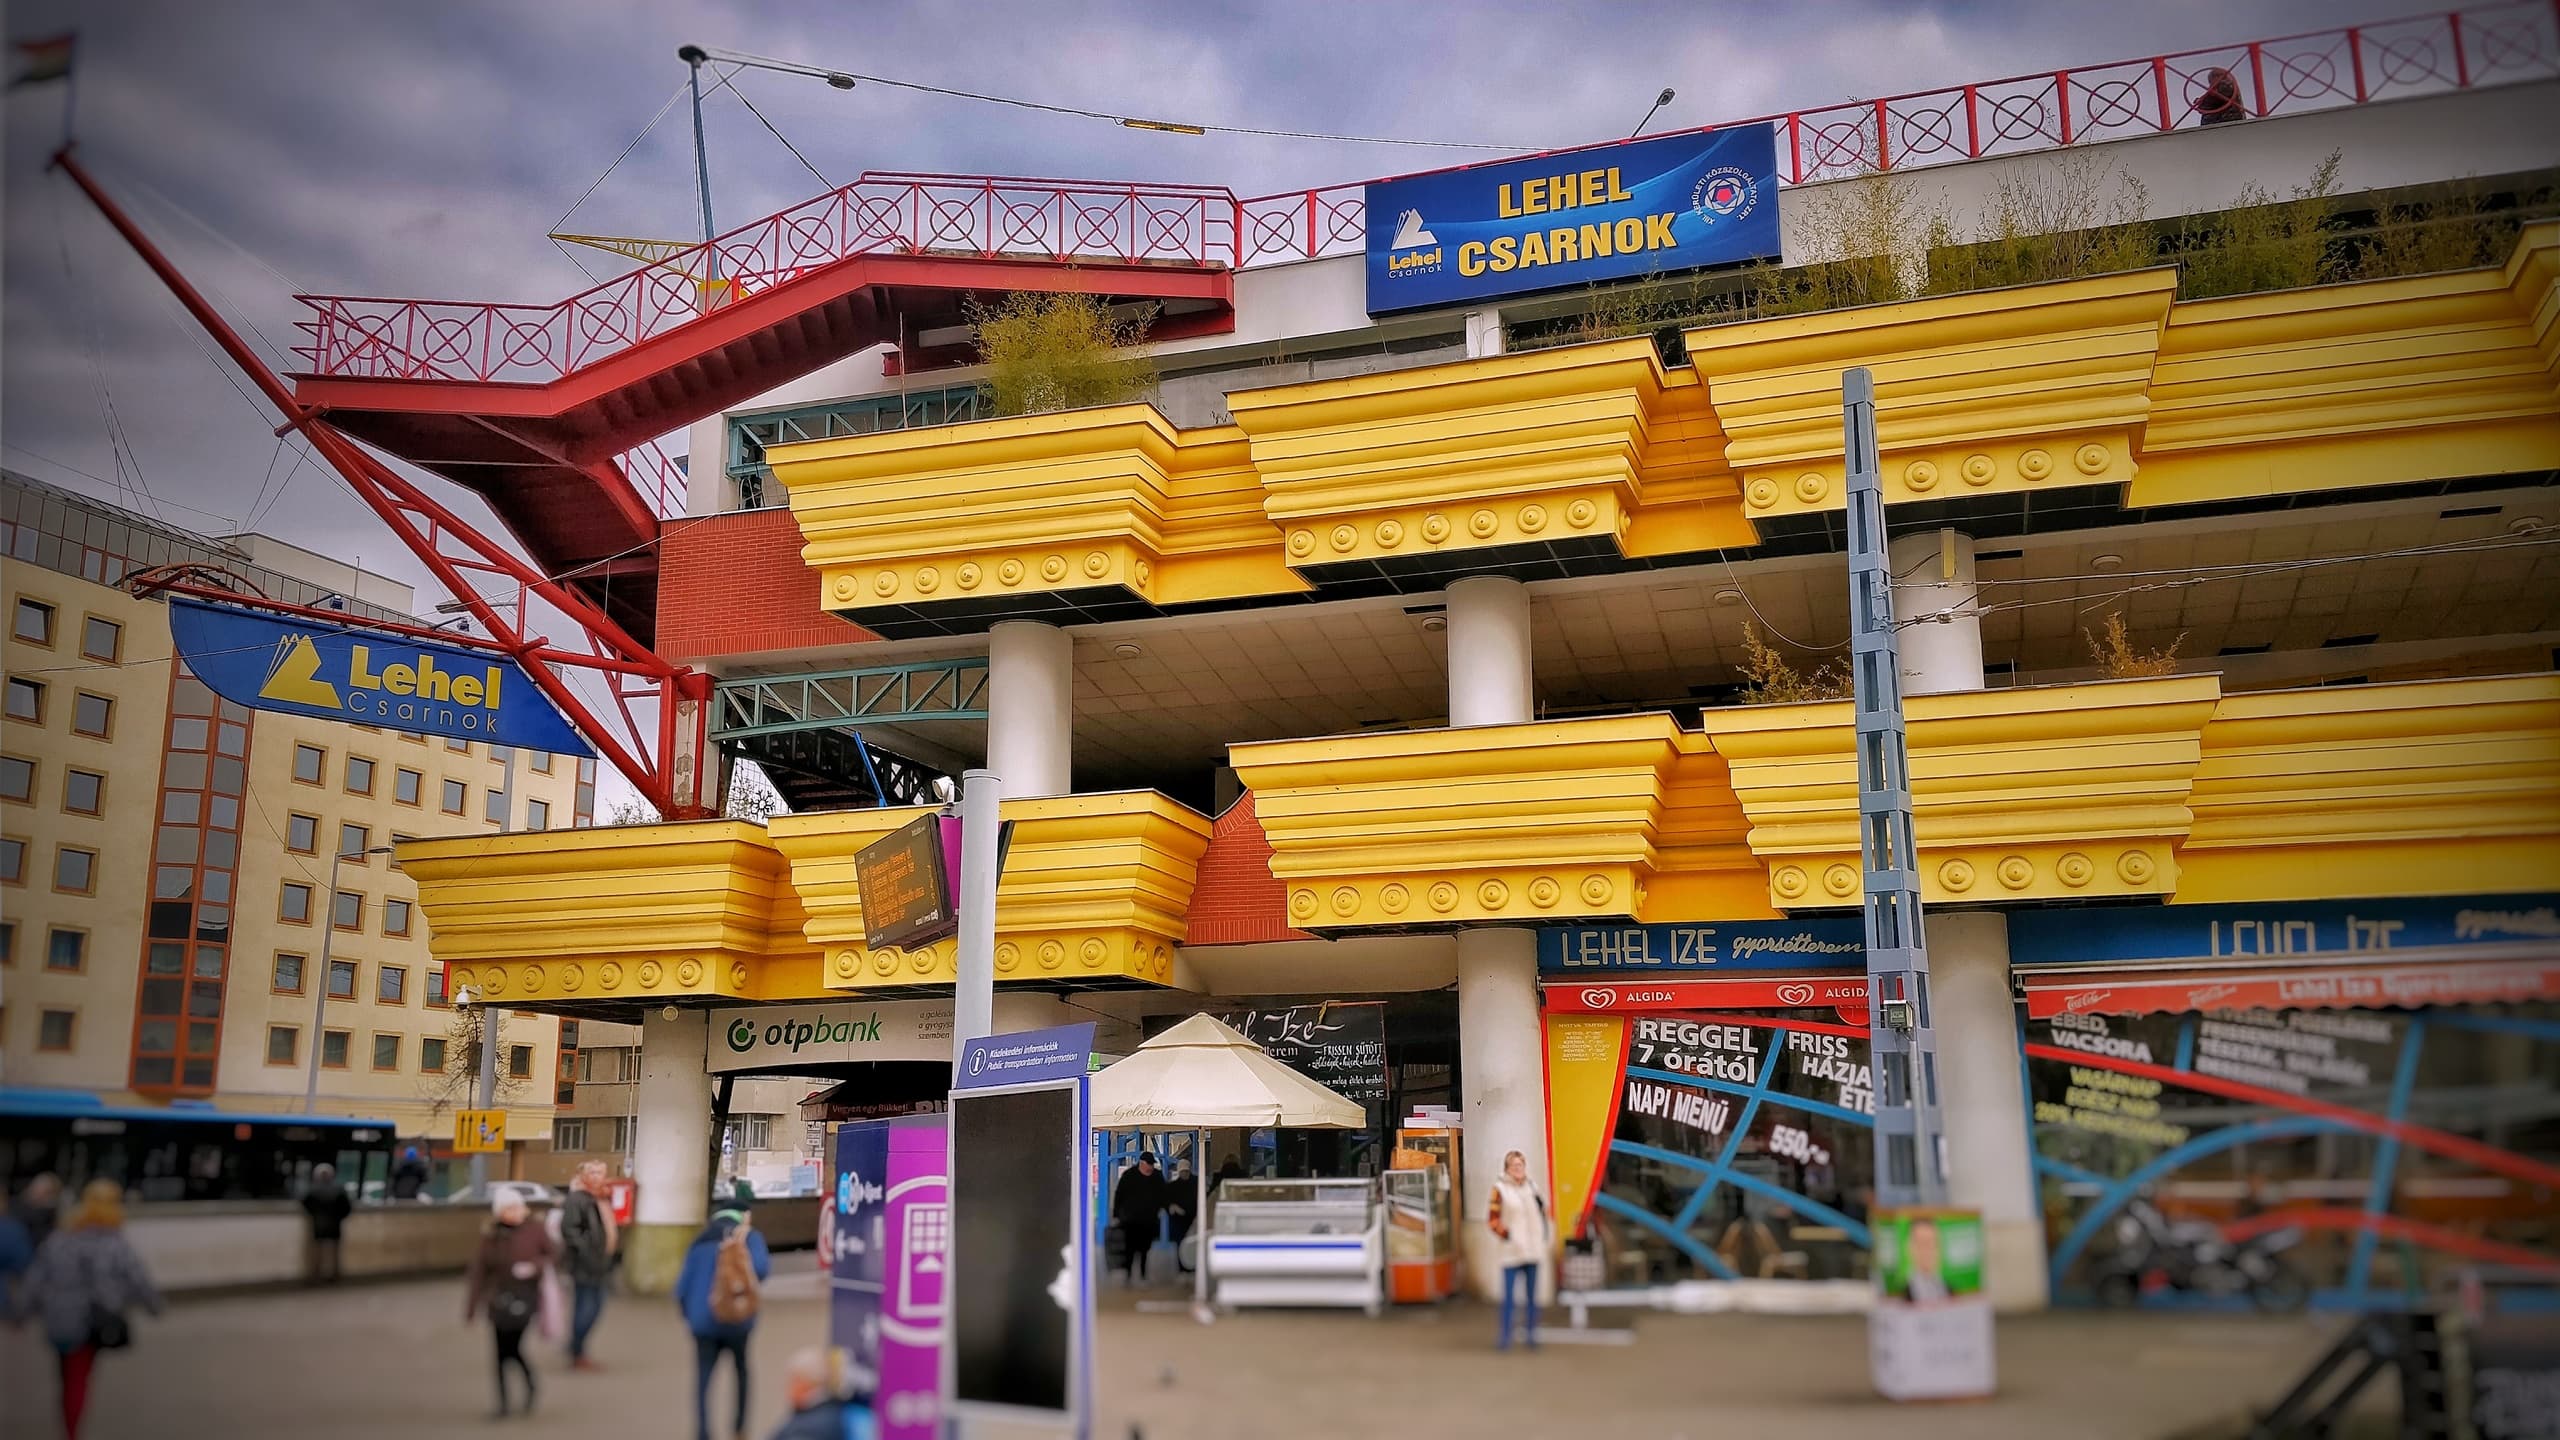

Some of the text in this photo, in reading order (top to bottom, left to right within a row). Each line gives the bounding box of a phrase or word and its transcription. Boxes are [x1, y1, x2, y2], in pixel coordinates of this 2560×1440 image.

[1499, 167, 1631, 218] LEHEL
[1389, 247, 1442, 270] Lehel
[1458, 212, 1677, 277] CSARNOK
[1388, 264, 1442, 279] Csarnok
[349, 645, 502, 710] Lehel
[348, 691, 497, 733] Csarnok
[1561, 929, 1866, 967] LEHEL IZE gyorsétterem
[1626, 991, 1673, 1002] ALGIDA
[764, 1011, 882, 1053] otpbank
[1323, 1044, 1352, 1056] FRISSEN
[1639, 1019, 1759, 1054] REGGEL
[1788, 1031, 1848, 1059] FRISS
[2051, 1028, 2154, 1065] VACSORA
[986, 1060, 1004, 1070] Public
[1043, 1052, 1078, 1066] information
[1638, 1043, 1655, 1064] 7
[1663, 1046, 1756, 1084] órától
[1802, 1055, 1873, 1089] HÁZIA
[1112, 1102, 1177, 1123] Gelateria
[1628, 1081, 1729, 1135] NAPI MENÜ
